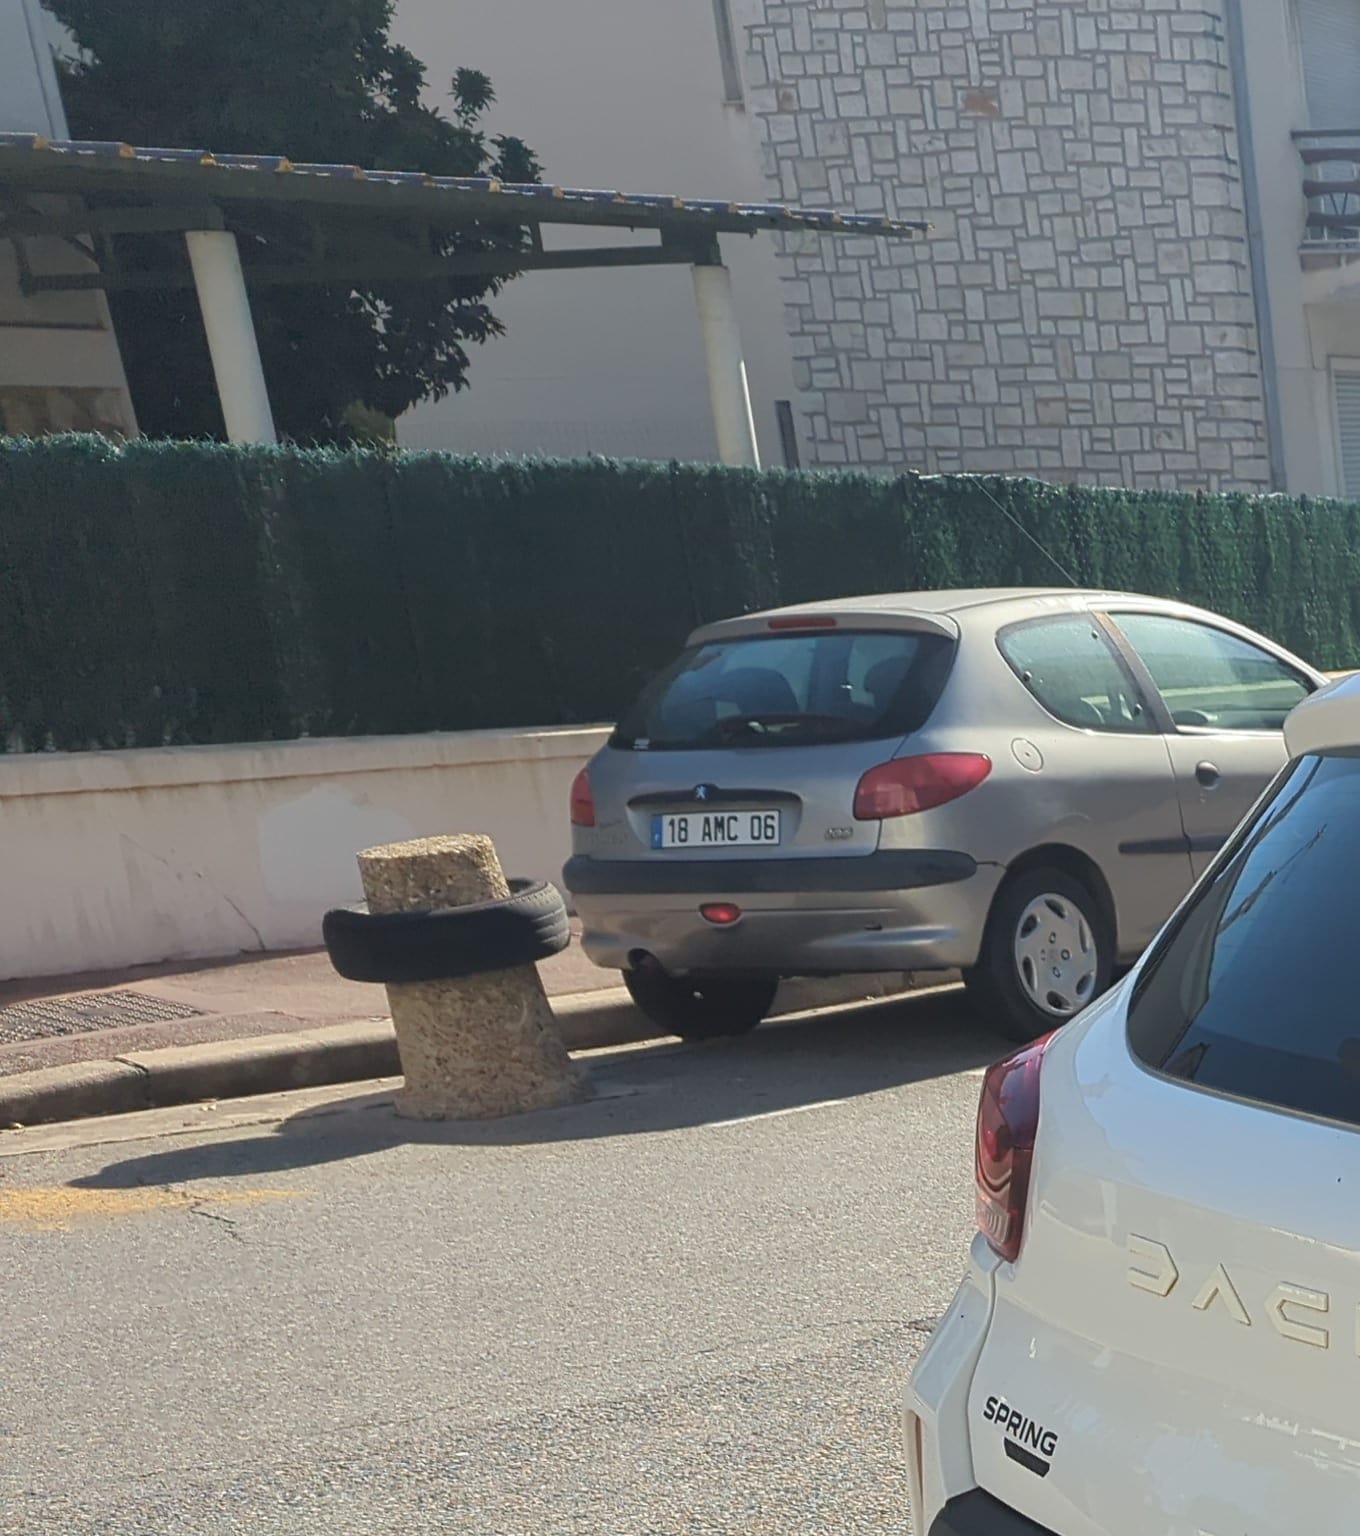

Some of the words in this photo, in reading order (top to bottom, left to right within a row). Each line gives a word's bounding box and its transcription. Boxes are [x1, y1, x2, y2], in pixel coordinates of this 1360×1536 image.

[668, 817, 688, 843] 18
[702, 815, 738, 842] AMC
[750, 815, 775, 840] 06
[983, 1396, 1058, 1457] SPRING
